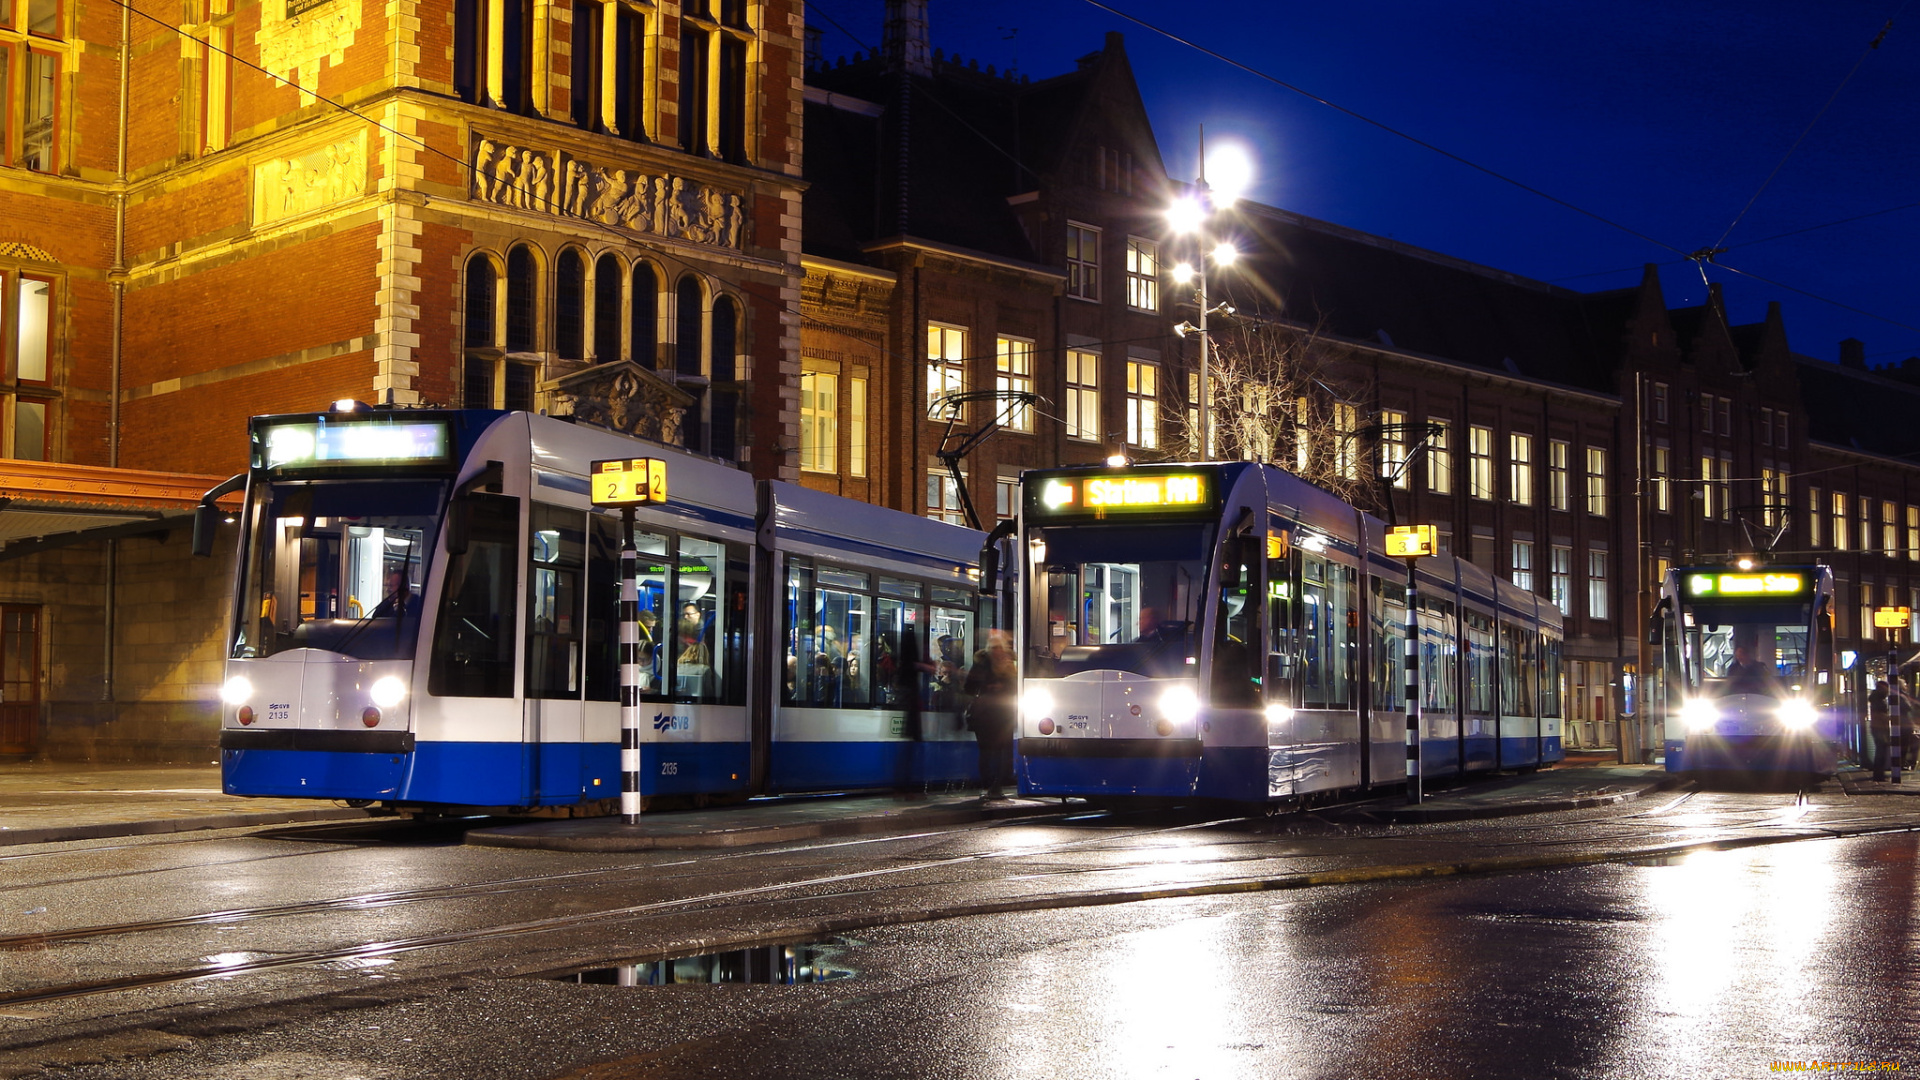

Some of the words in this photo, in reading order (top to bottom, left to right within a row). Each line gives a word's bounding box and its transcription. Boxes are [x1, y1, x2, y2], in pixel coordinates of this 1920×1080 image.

[608, 483, 618, 499] 2
[654, 474, 662, 495] 2
[1398, 541, 1407, 553] 3
[268, 711, 289, 720] 2135
[671, 715, 689, 730] GVB
[661, 762, 678, 775] 2135
